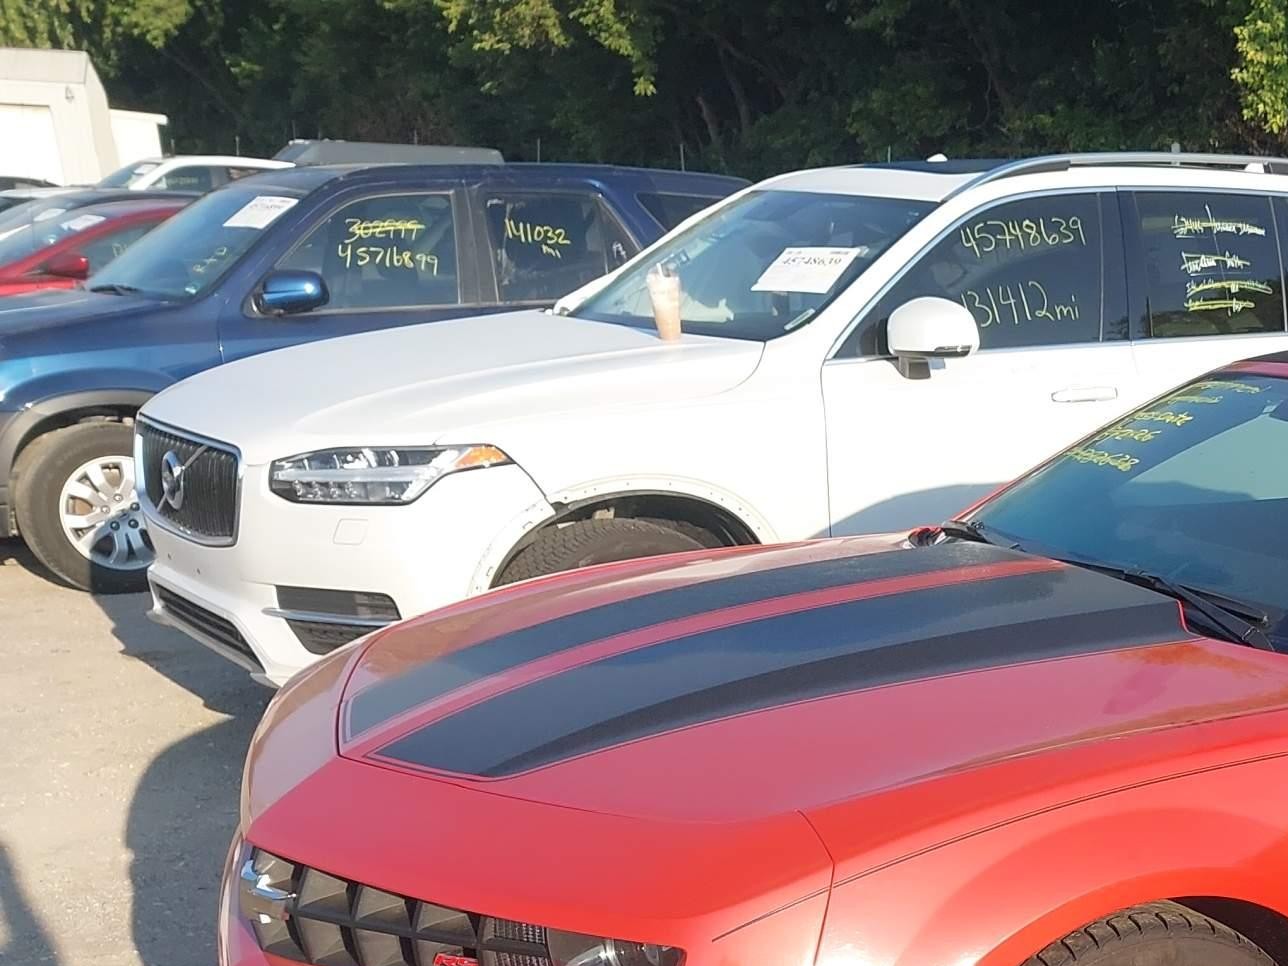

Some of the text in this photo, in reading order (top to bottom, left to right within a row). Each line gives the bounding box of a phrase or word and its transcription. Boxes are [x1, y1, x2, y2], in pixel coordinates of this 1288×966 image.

[505, 217, 571, 244] 141032
[960, 216, 1086, 258] 45748639
[338, 244, 438, 276] 45716899
